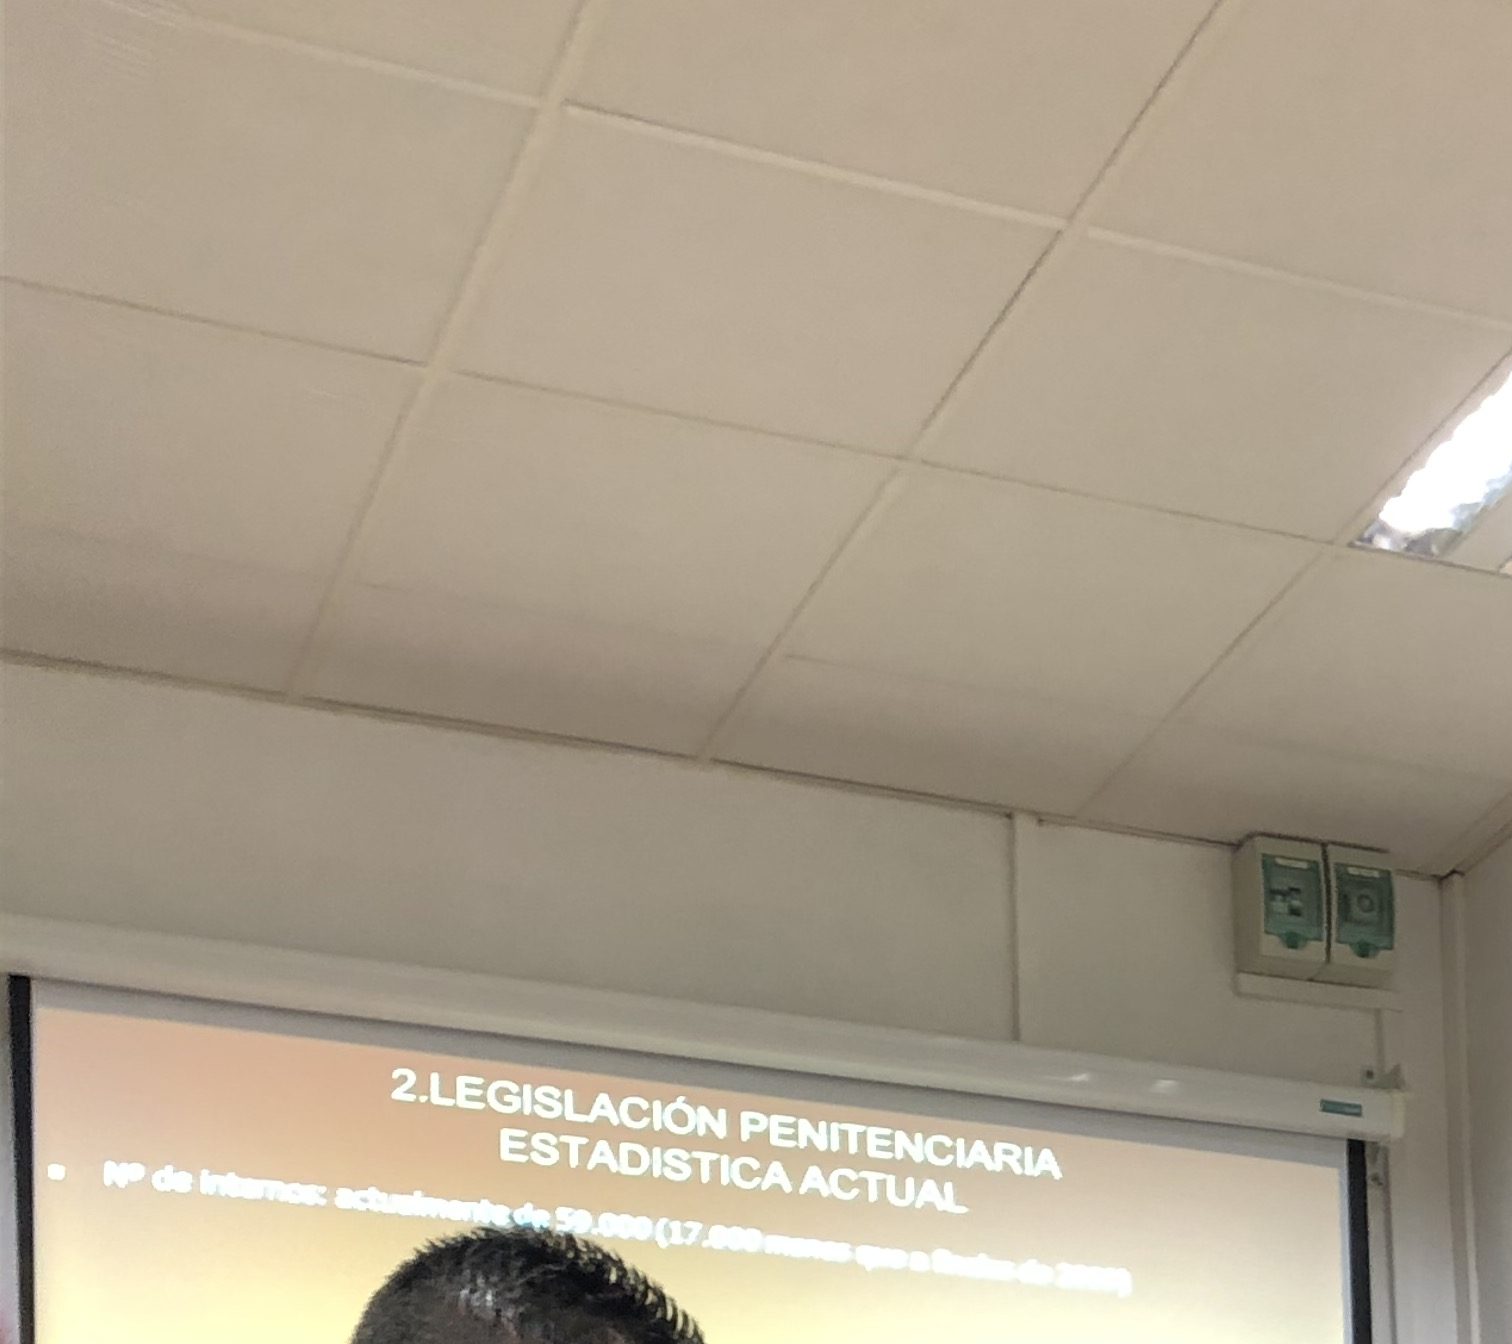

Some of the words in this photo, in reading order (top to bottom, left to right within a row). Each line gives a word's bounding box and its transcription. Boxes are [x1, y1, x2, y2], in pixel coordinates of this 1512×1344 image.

[391, 1067, 728, 1140] 2.LEGISLACIÓN
[740, 1111, 1063, 1181] PENITENCIARIA
[500, 1128, 793, 1195] ESTADISTICA
[799, 1168, 970, 1214] ACTUAL
